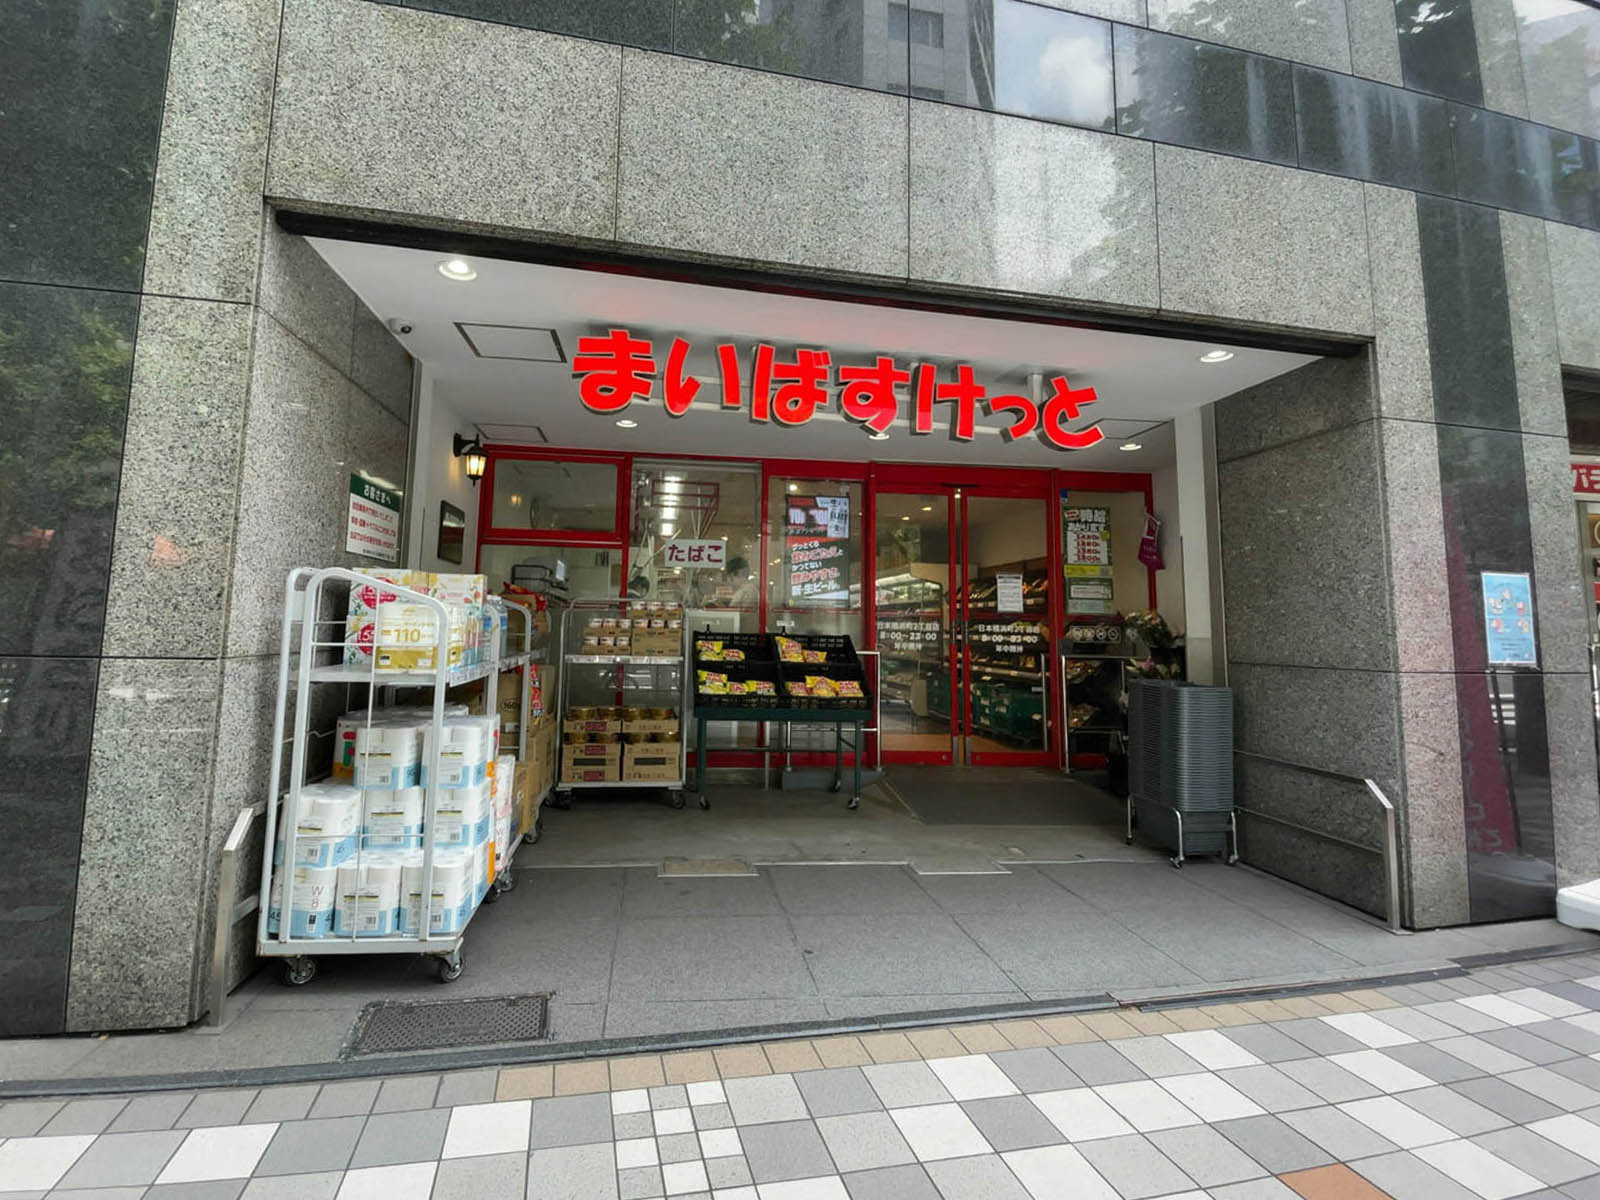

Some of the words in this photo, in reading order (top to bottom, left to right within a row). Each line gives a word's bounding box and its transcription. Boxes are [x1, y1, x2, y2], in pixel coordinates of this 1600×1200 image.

[572, 329, 1106, 450] まいばすけっと
[668, 543, 723, 563] たばこ
[394, 628, 421, 643] 110
